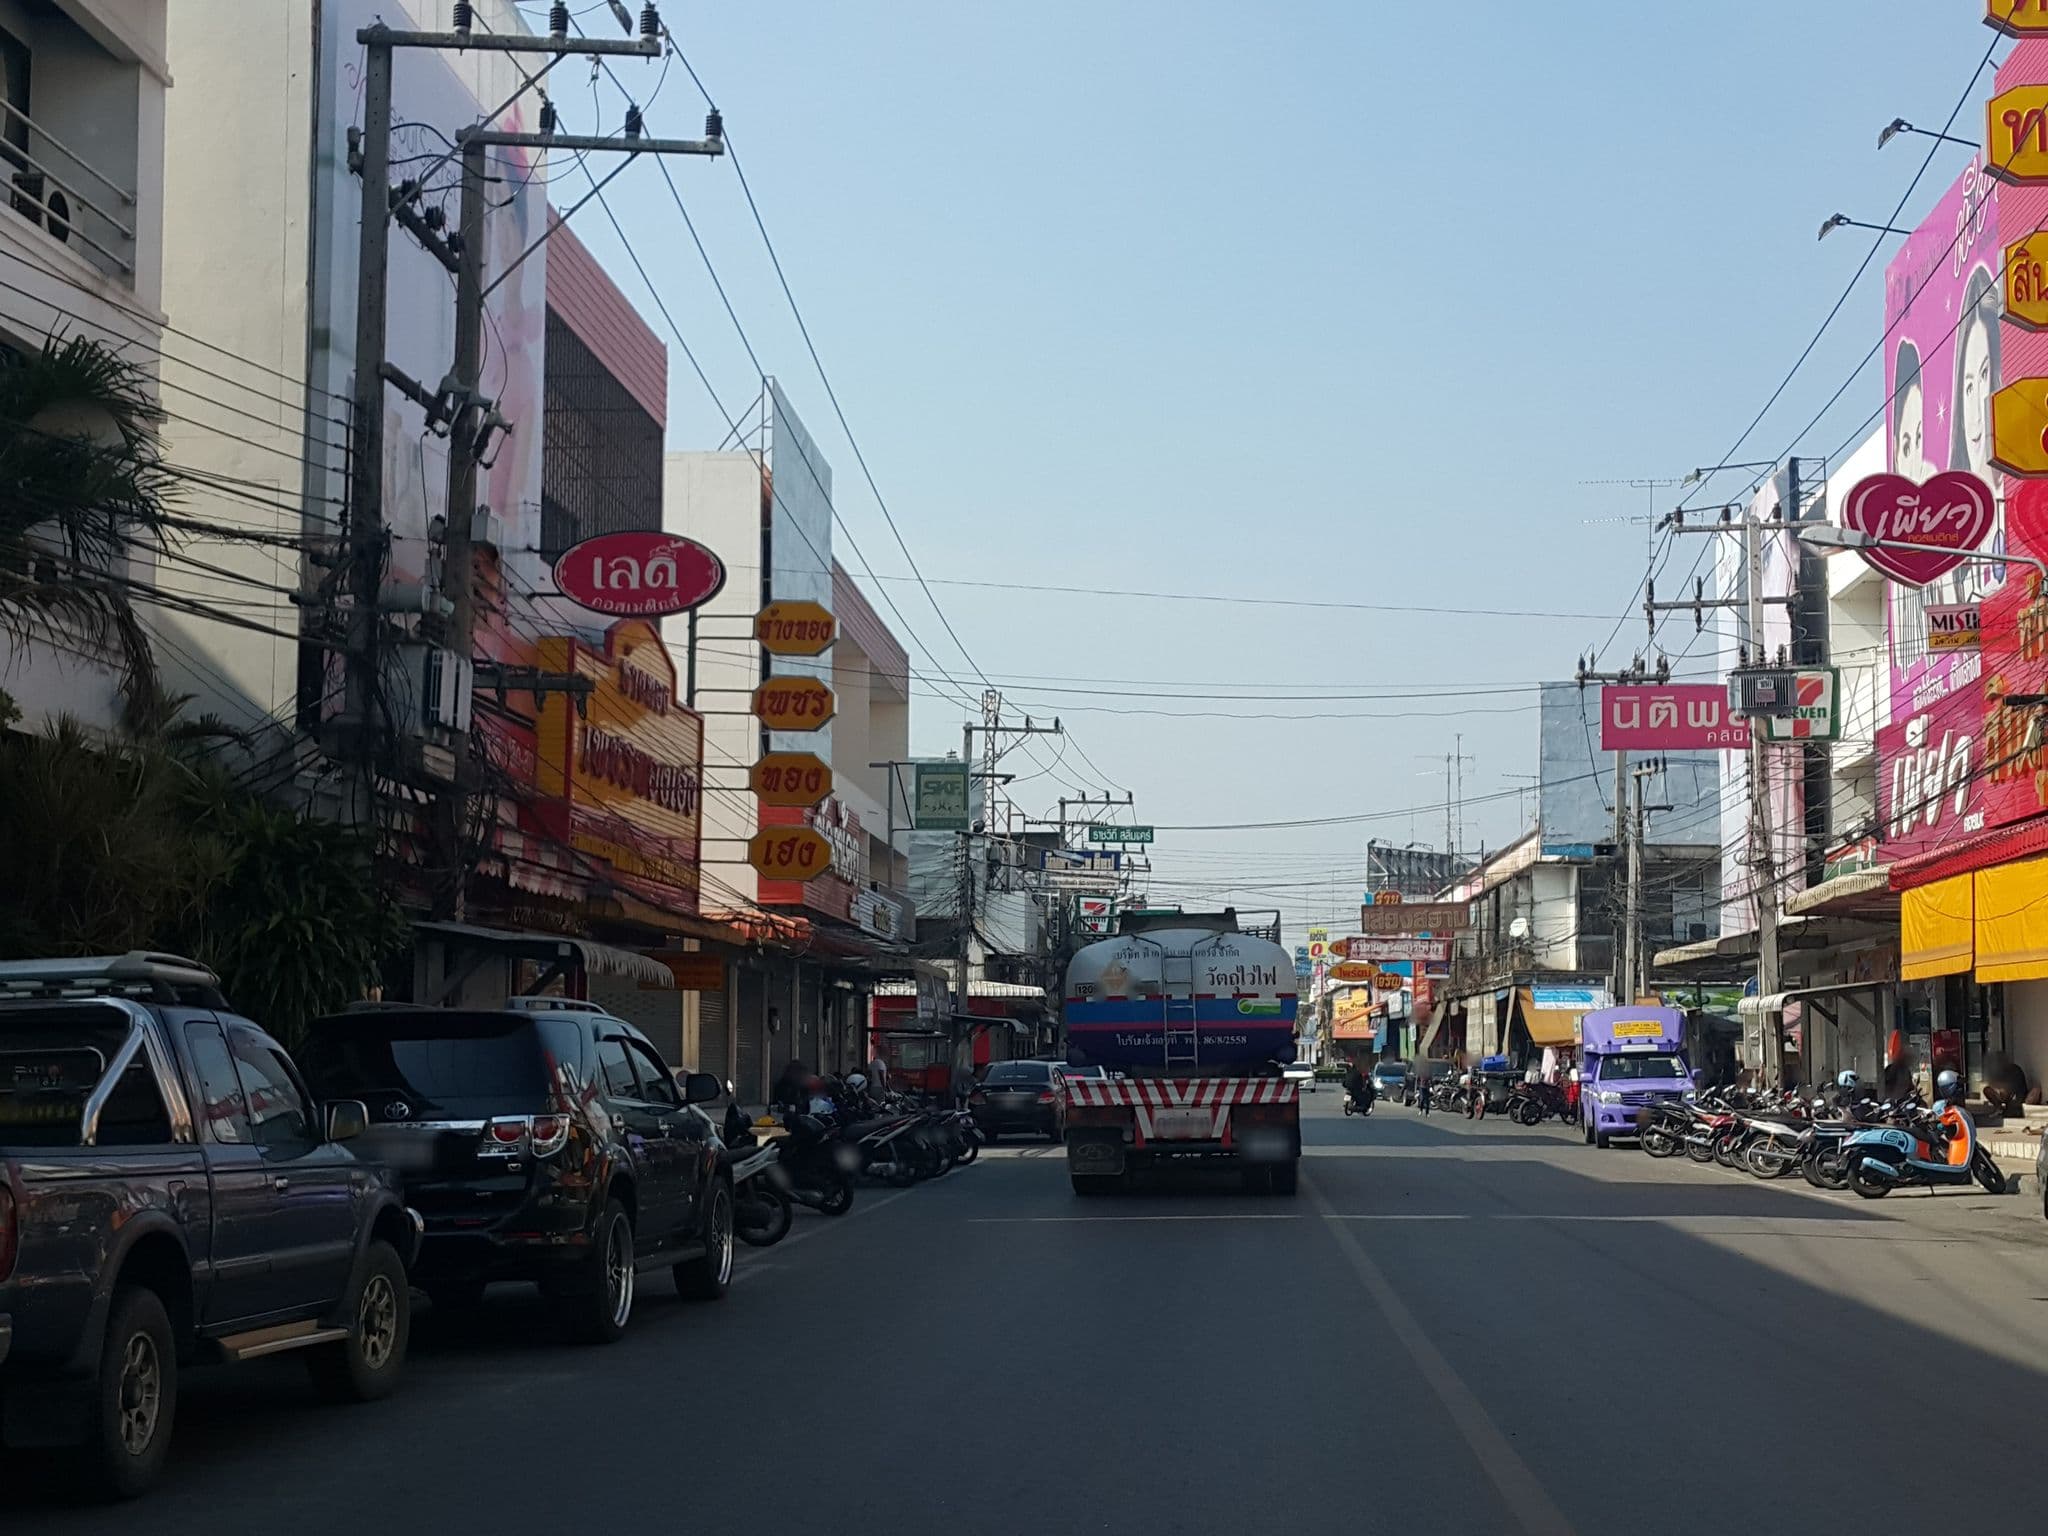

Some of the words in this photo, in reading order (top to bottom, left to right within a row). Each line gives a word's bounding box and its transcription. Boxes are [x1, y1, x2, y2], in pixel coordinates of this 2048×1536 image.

[1875, 494, 1972, 541] เพียว
[593, 540, 685, 590] เลดี้
[761, 766, 822, 793] ทอง
[763, 837, 817, 867] เฮง
